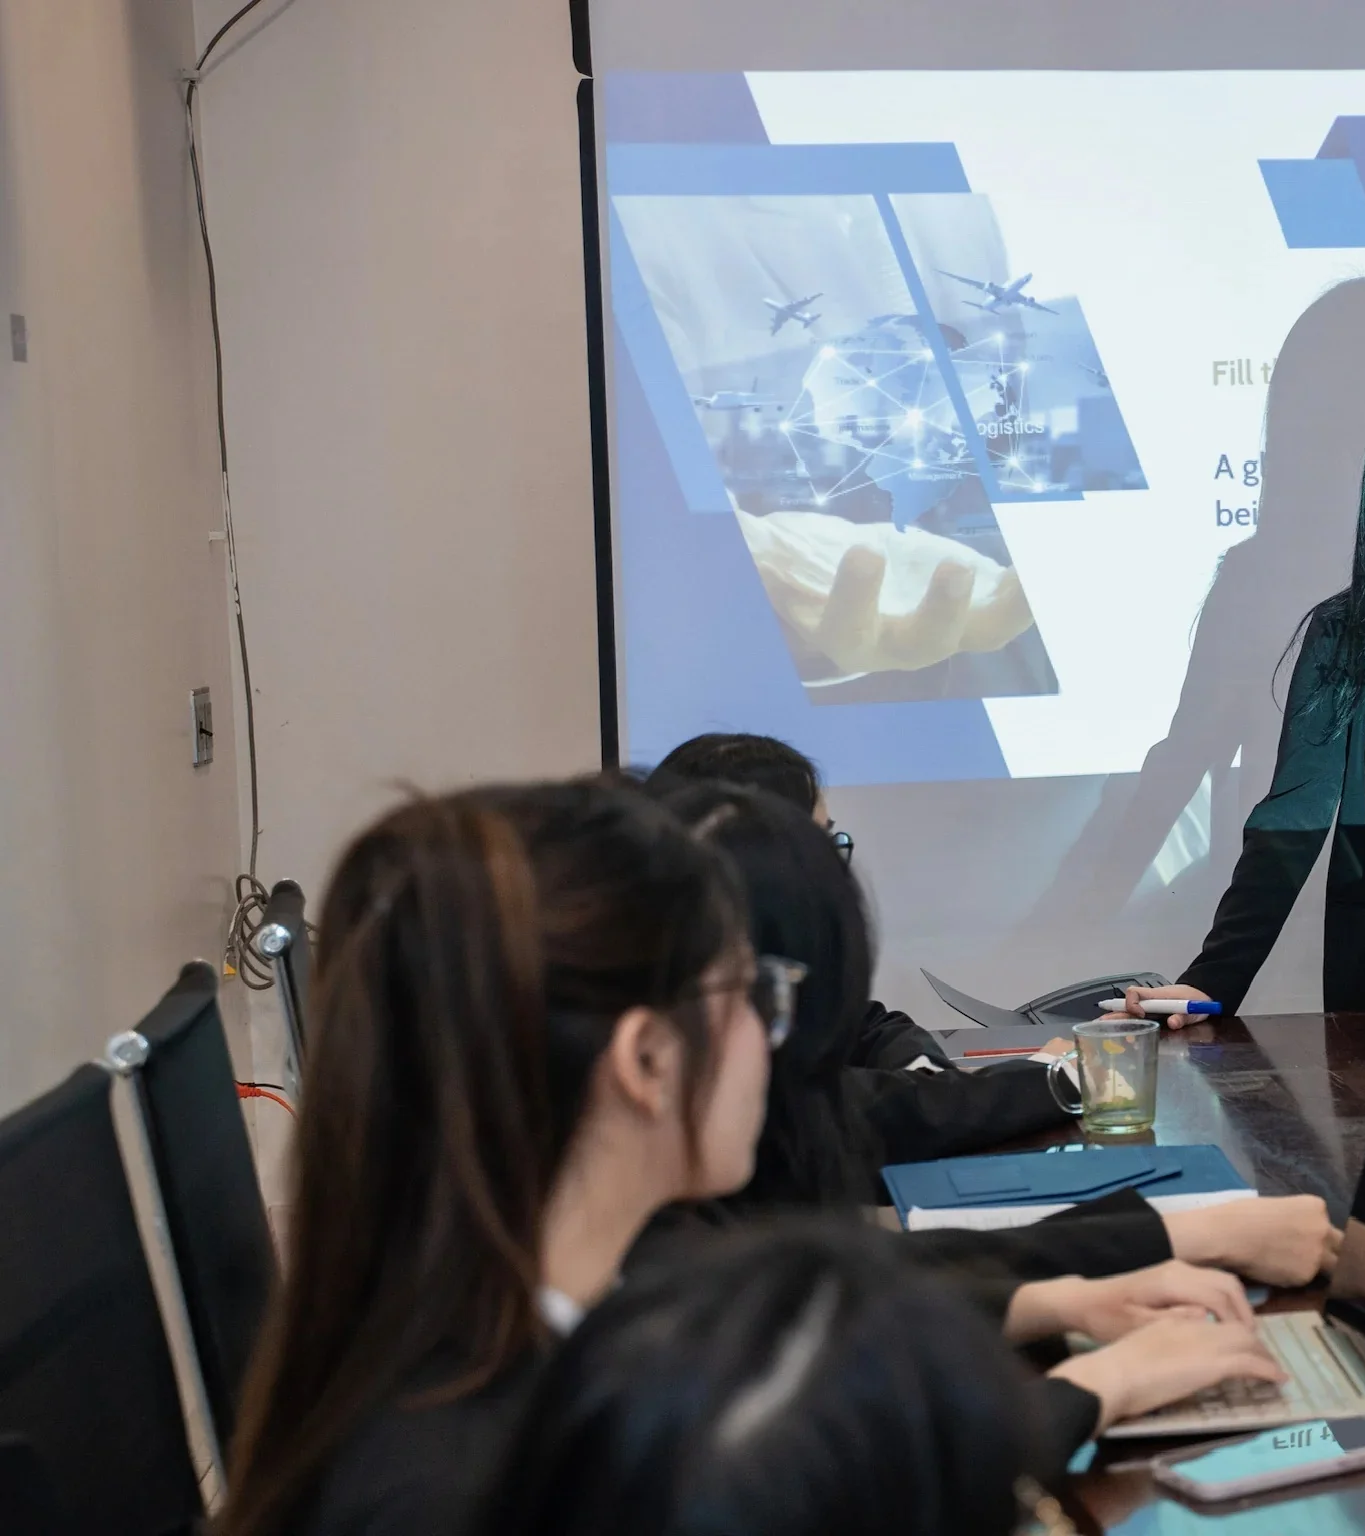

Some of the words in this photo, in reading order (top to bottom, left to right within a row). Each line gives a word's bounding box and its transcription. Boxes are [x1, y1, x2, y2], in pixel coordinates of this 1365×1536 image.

[1212, 358, 1254, 387] Fill
[977, 418, 1045, 439] ogistics
[1214, 453, 1235, 480] A
